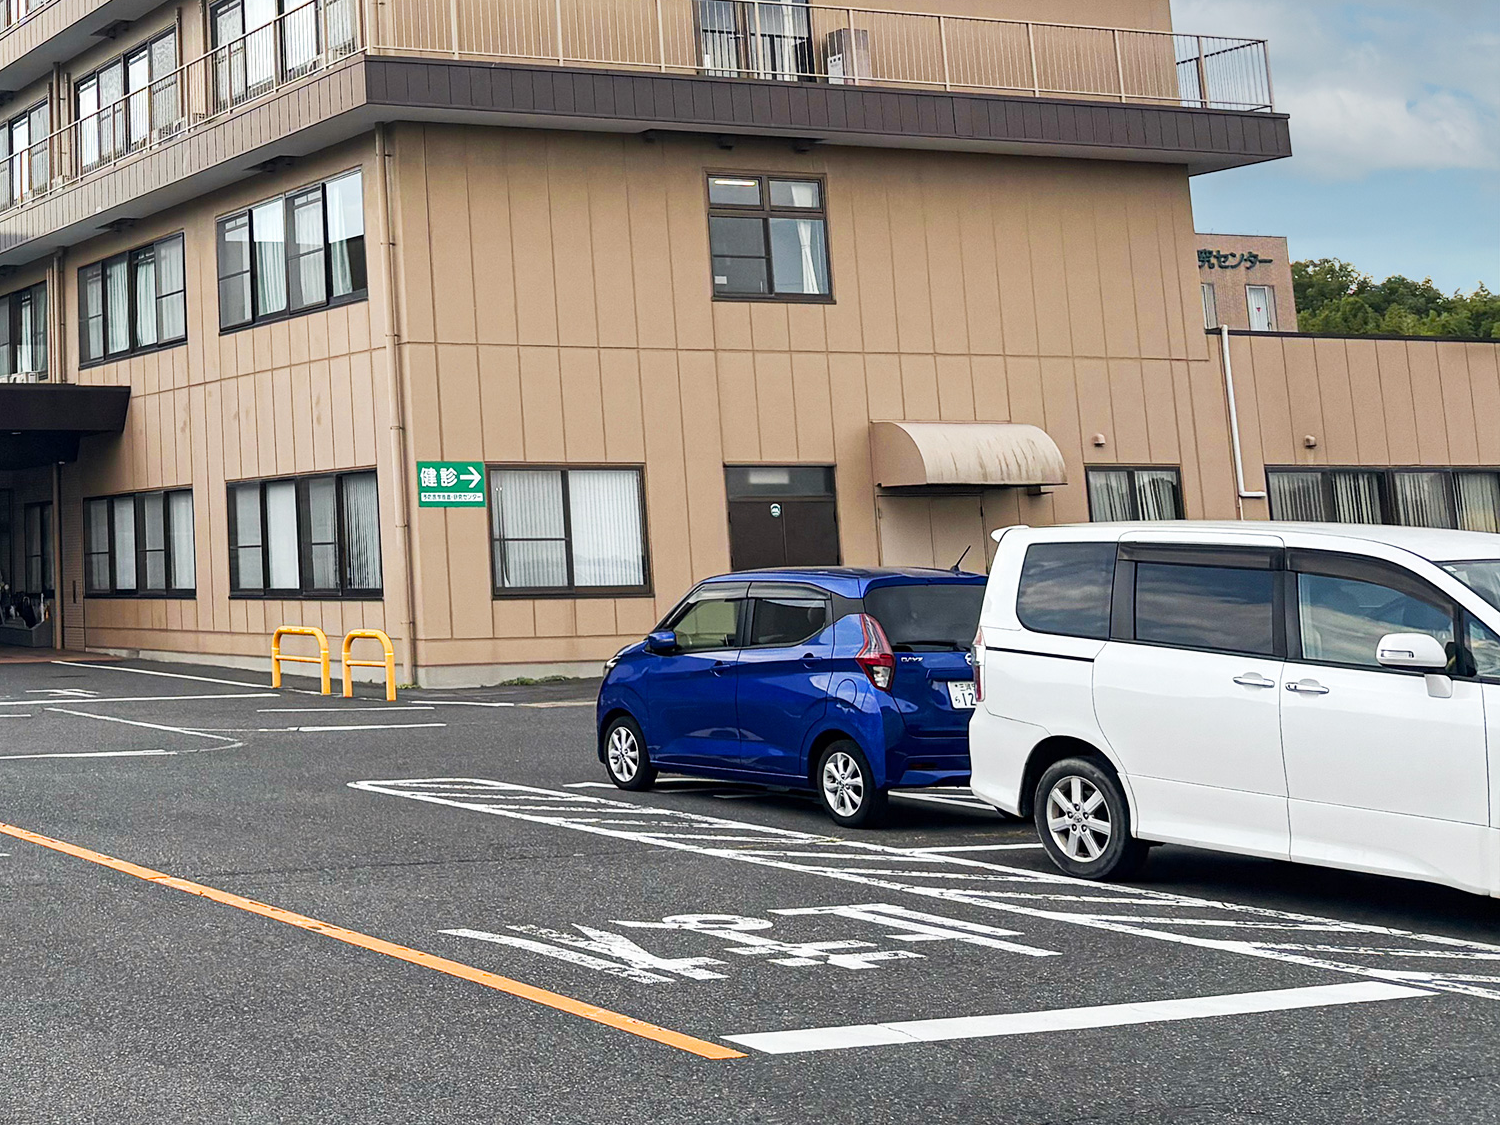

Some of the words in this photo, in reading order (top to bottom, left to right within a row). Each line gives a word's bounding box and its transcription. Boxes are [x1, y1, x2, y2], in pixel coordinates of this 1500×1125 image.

[1197, 249, 1273, 270] 究センター
[420, 467, 458, 487] 健診
